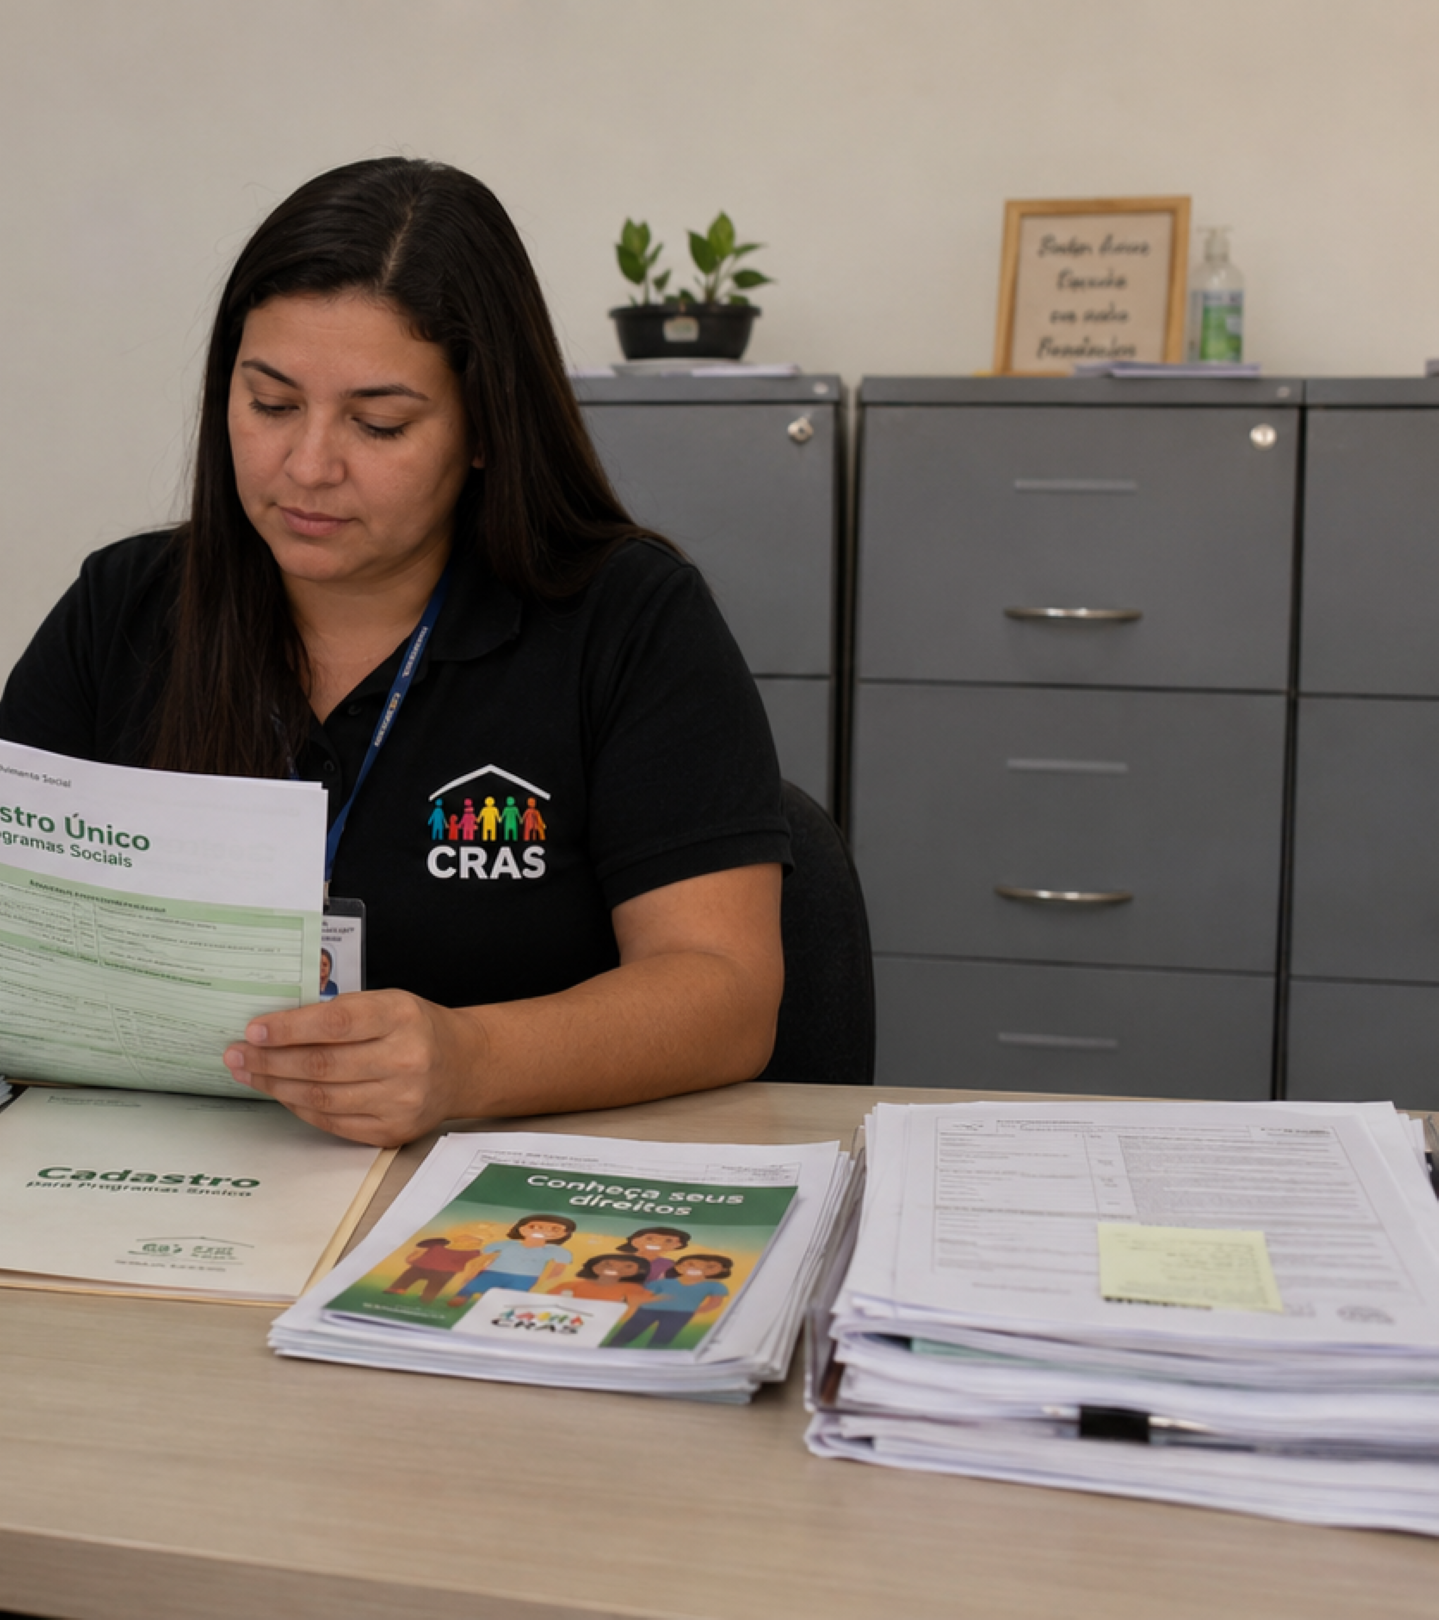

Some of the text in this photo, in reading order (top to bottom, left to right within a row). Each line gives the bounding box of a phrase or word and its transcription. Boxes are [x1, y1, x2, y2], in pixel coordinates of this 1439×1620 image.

[65, 813, 150, 850] Único
[70, 844, 132, 868] Sociais
[427, 845, 546, 879] CRAS
[37, 1166, 260, 1188] Cadastro
[527, 1175, 744, 1204] Conheça seus
[569, 1194, 692, 1215] direitos
